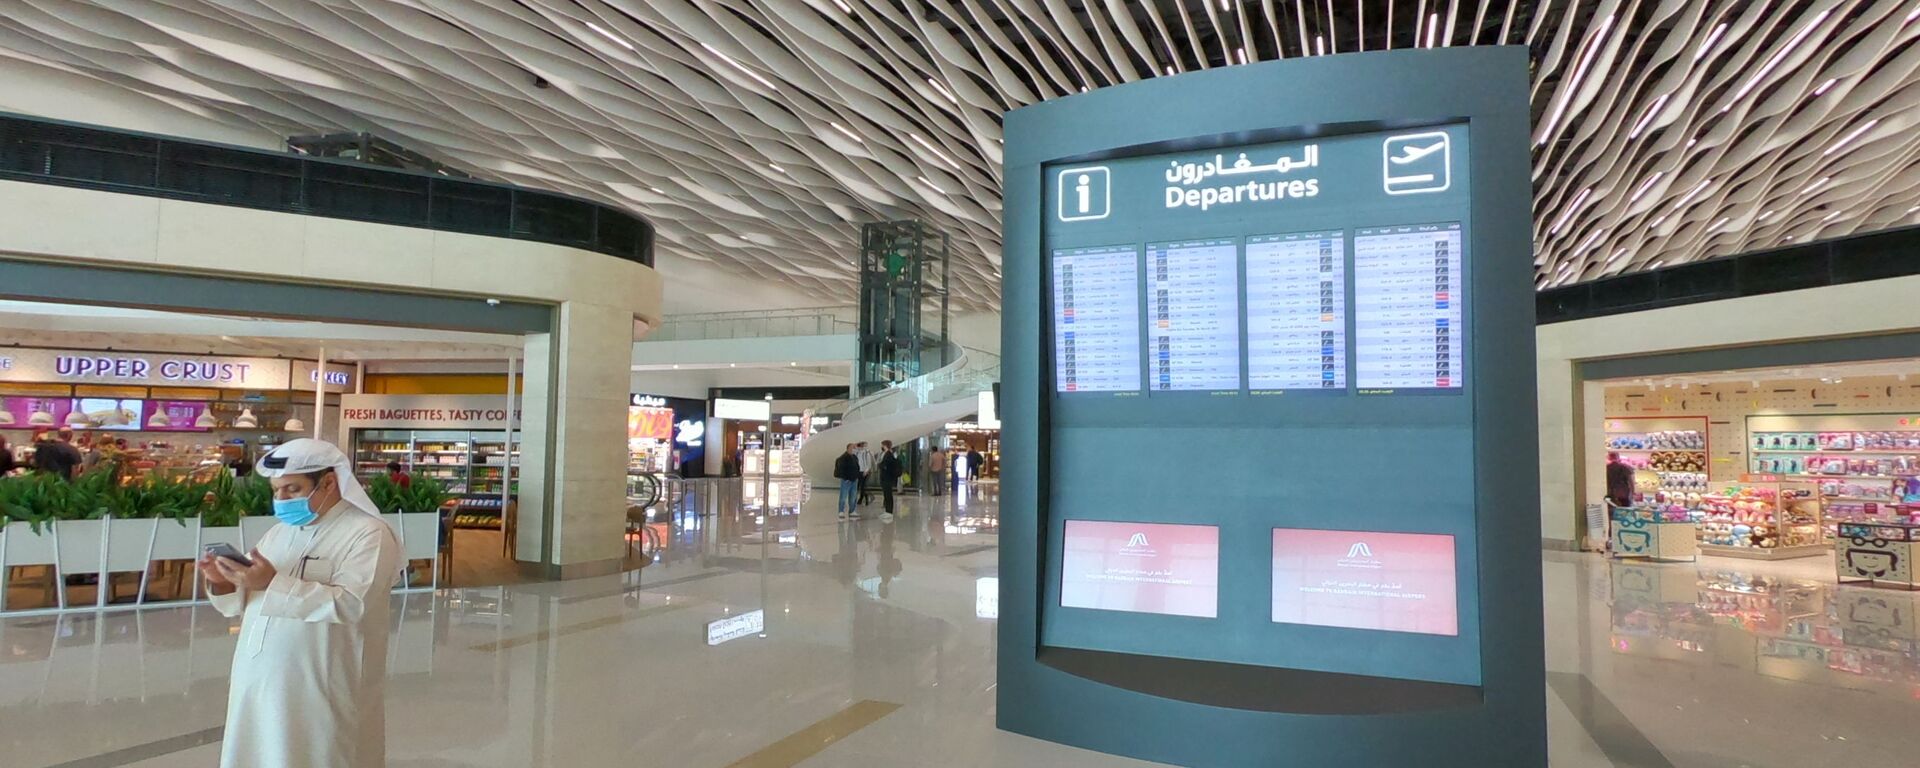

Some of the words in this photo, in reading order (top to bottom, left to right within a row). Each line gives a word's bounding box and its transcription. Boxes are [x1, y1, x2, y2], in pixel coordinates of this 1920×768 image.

[1166, 145, 1318, 184] المغادرون
[1165, 178, 1319, 210] Departures
[56, 356, 147, 377] UPPER
[161, 361, 250, 383] CRUST
[312, 370, 349, 384] BKERY
[344, 409, 377, 420] FRESH
[379, 409, 446, 421] BAGUETTES,
[449, 409, 483, 420] TASTY
